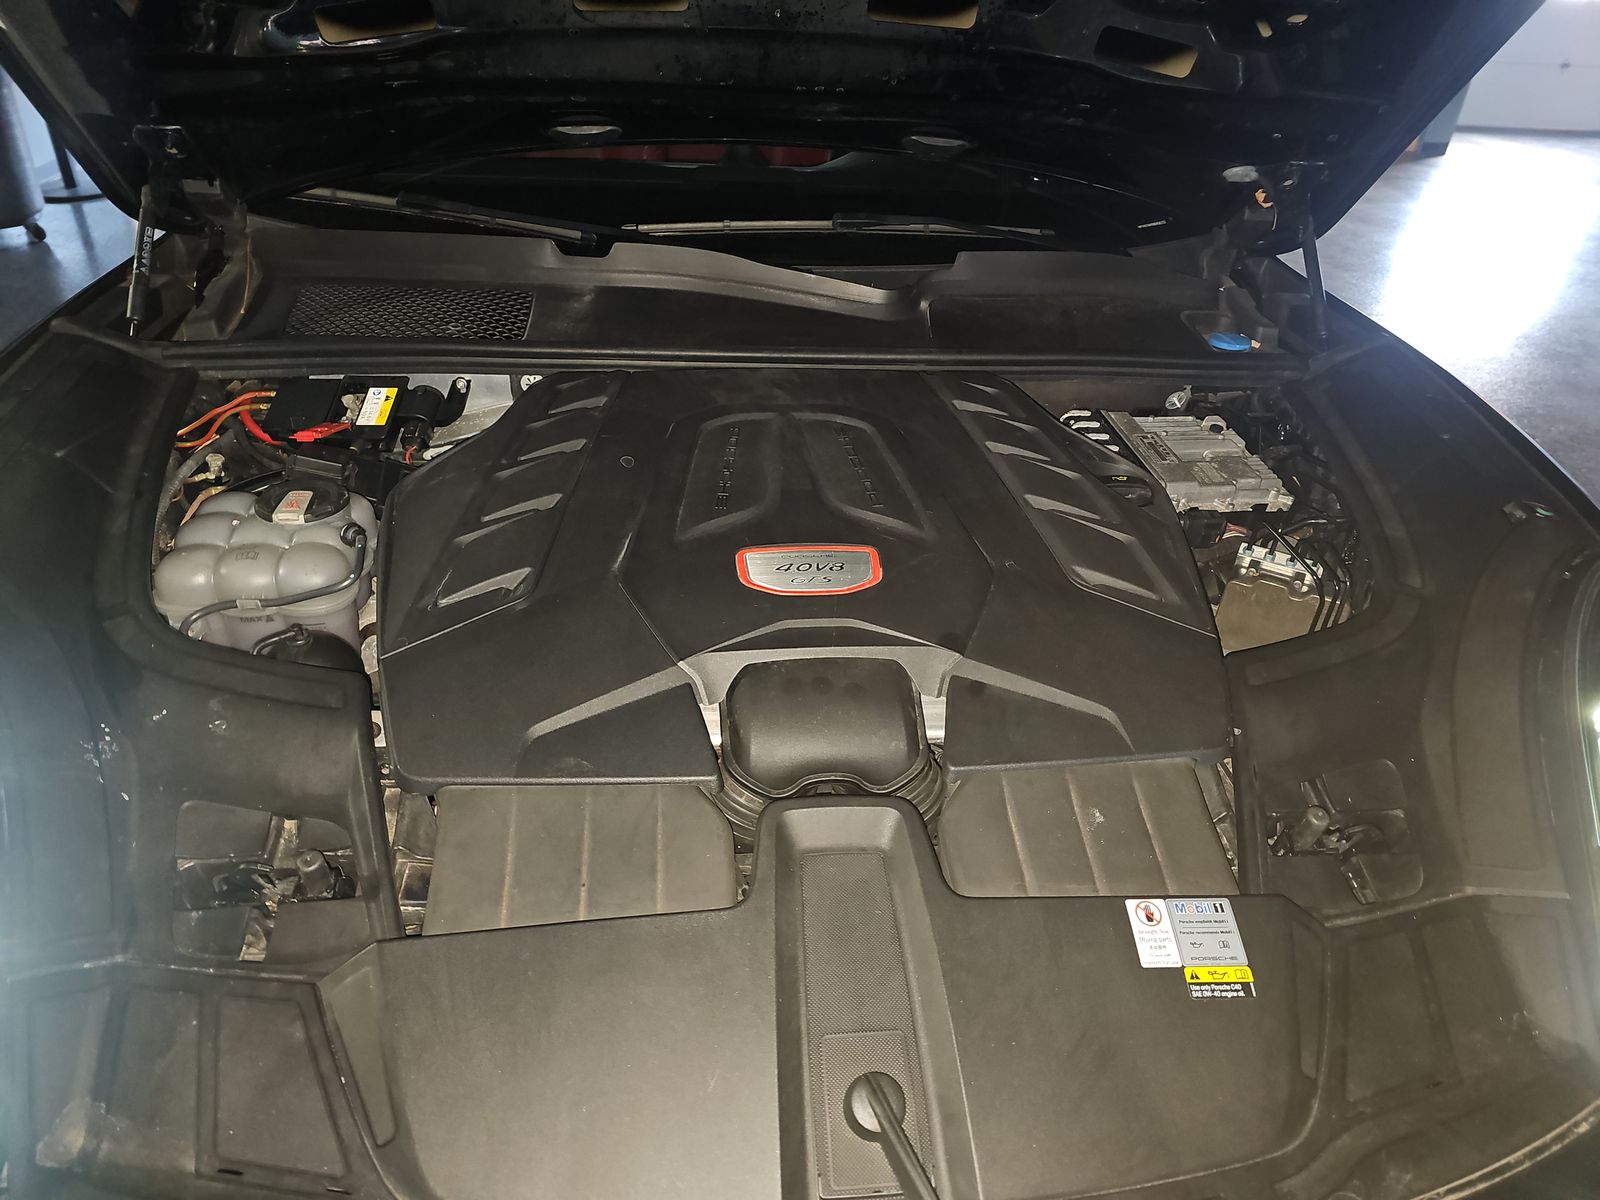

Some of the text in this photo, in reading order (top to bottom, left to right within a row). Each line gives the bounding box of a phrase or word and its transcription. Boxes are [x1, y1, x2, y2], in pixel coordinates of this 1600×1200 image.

[790, 576, 832, 584] GTS
[1174, 902, 1226, 914] Mobil 1
[1221, 991, 1238, 999] engine
